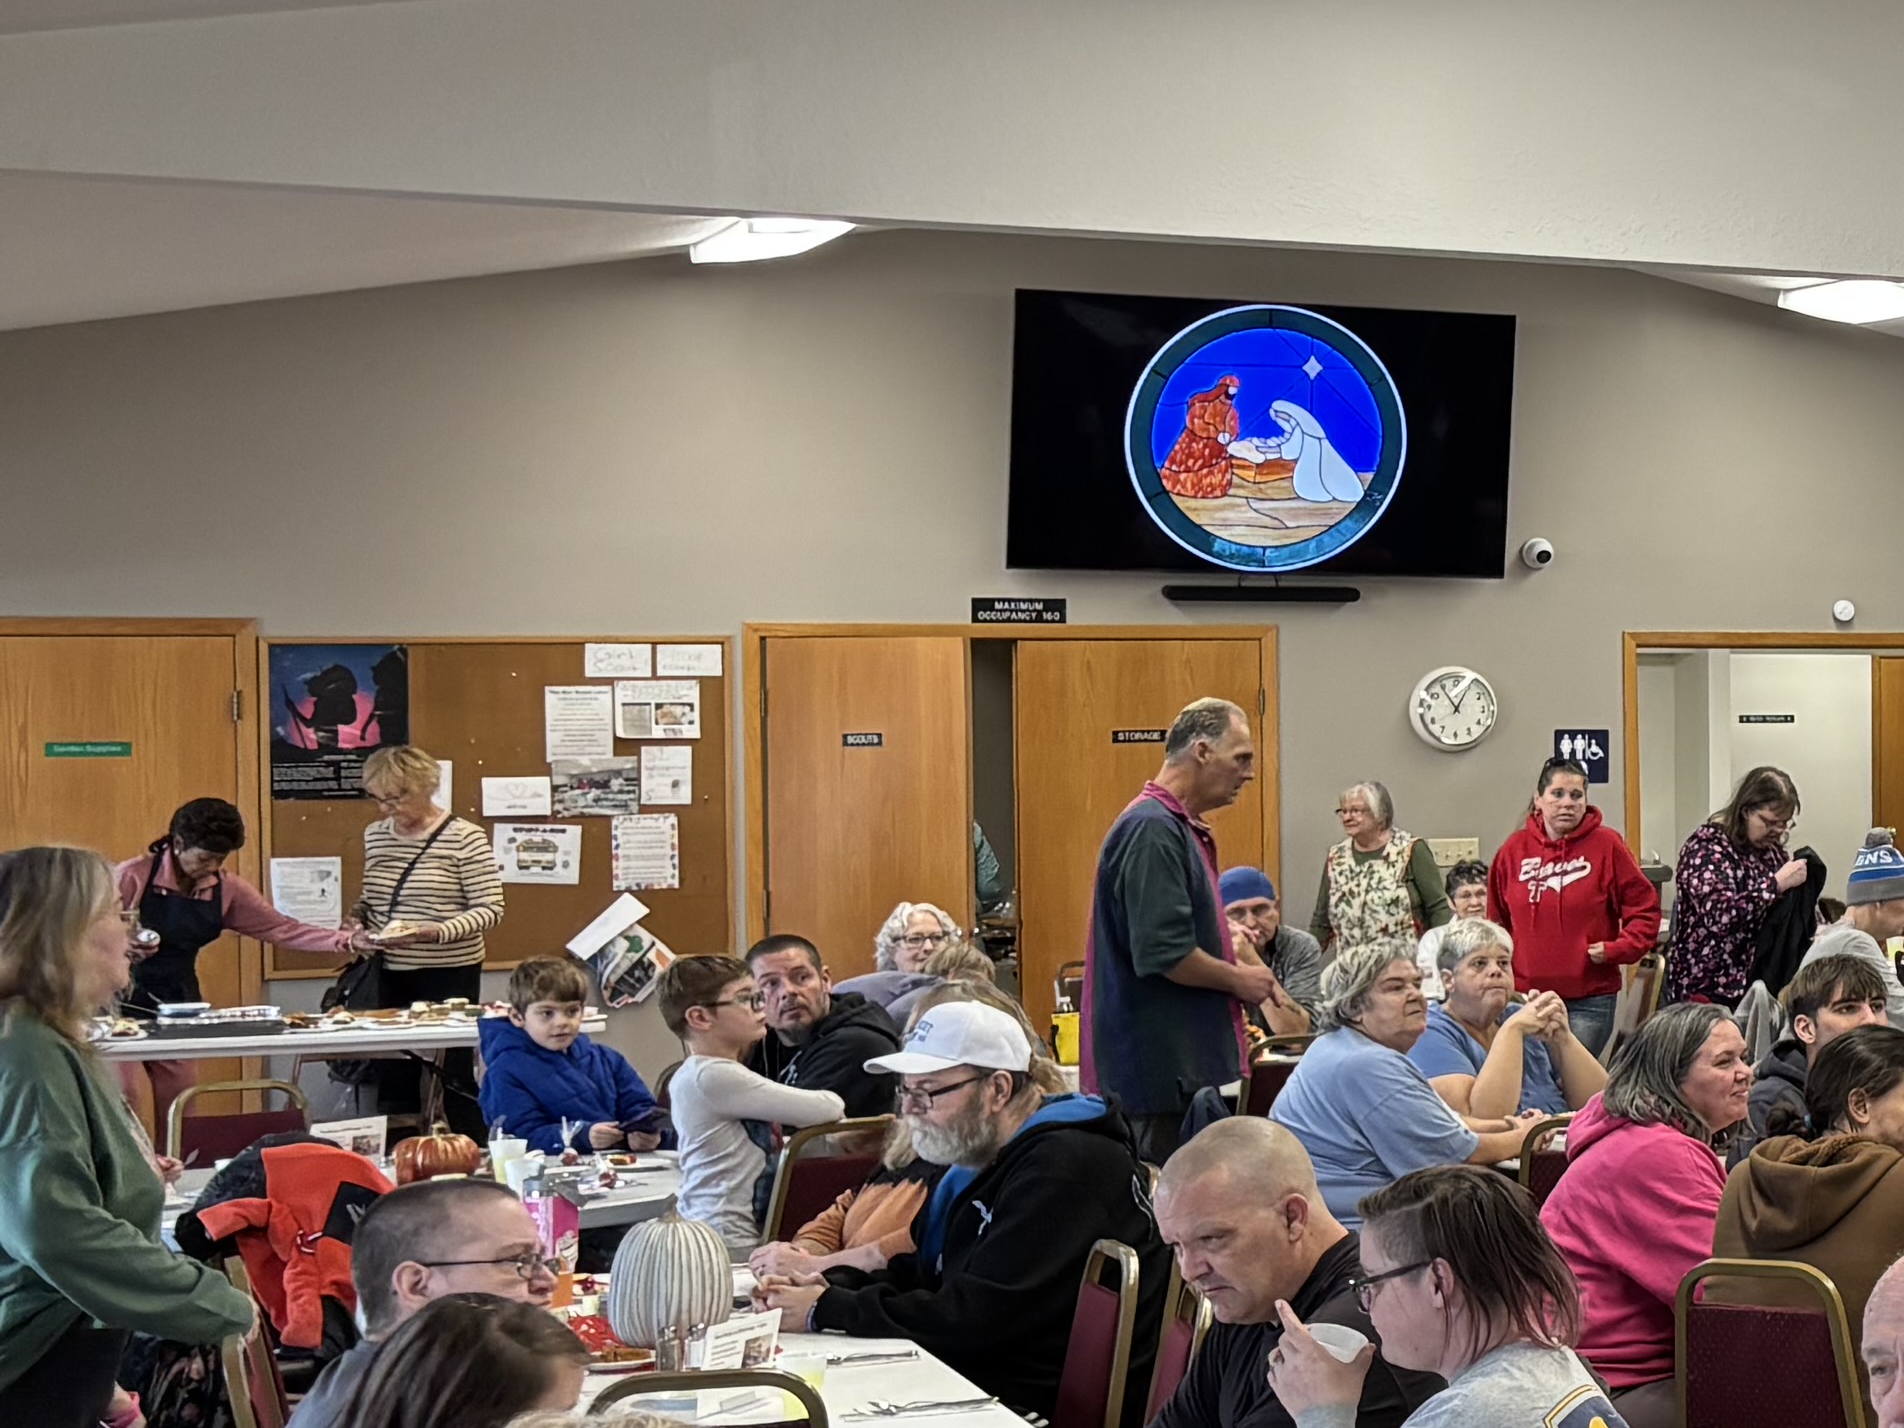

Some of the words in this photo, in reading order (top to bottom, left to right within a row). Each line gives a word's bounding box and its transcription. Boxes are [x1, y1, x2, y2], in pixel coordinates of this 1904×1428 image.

[994, 600, 1043, 610] MAXIMUM
[977, 611, 1037, 621] OCCUPANCY
[1117, 731, 1161, 741] STORAGE
